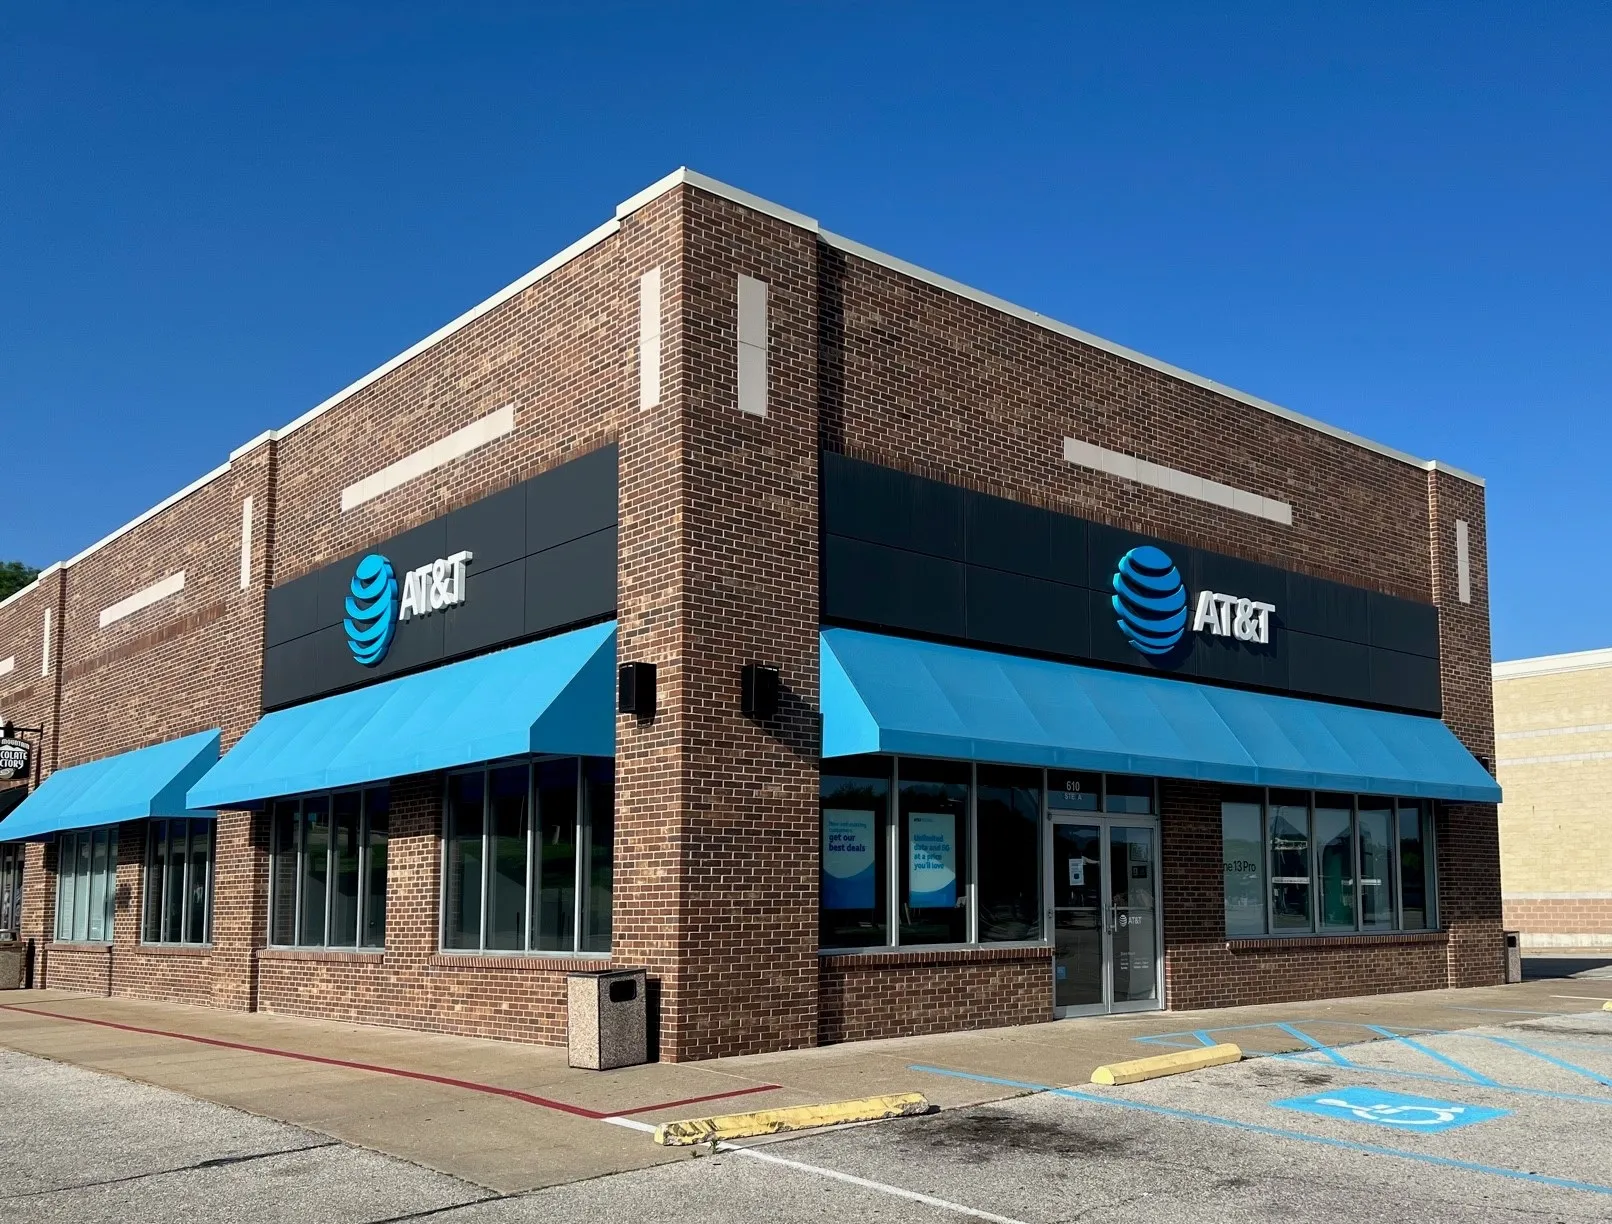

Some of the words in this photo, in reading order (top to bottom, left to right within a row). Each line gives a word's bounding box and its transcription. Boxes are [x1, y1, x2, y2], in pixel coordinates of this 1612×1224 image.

[399, 551, 473, 621] AT&T
[1193, 590, 1276, 644] AT&T
[1066, 781, 1080, 791] 610
[828, 834, 842, 843] get
[913, 834, 944, 842] Unlimited
[828, 843, 846, 851] best
[846, 844, 866, 852] deals
[913, 843, 928, 851] data
[1233, 860, 1242, 872] 13
[1243, 860, 1257, 872] Pro
